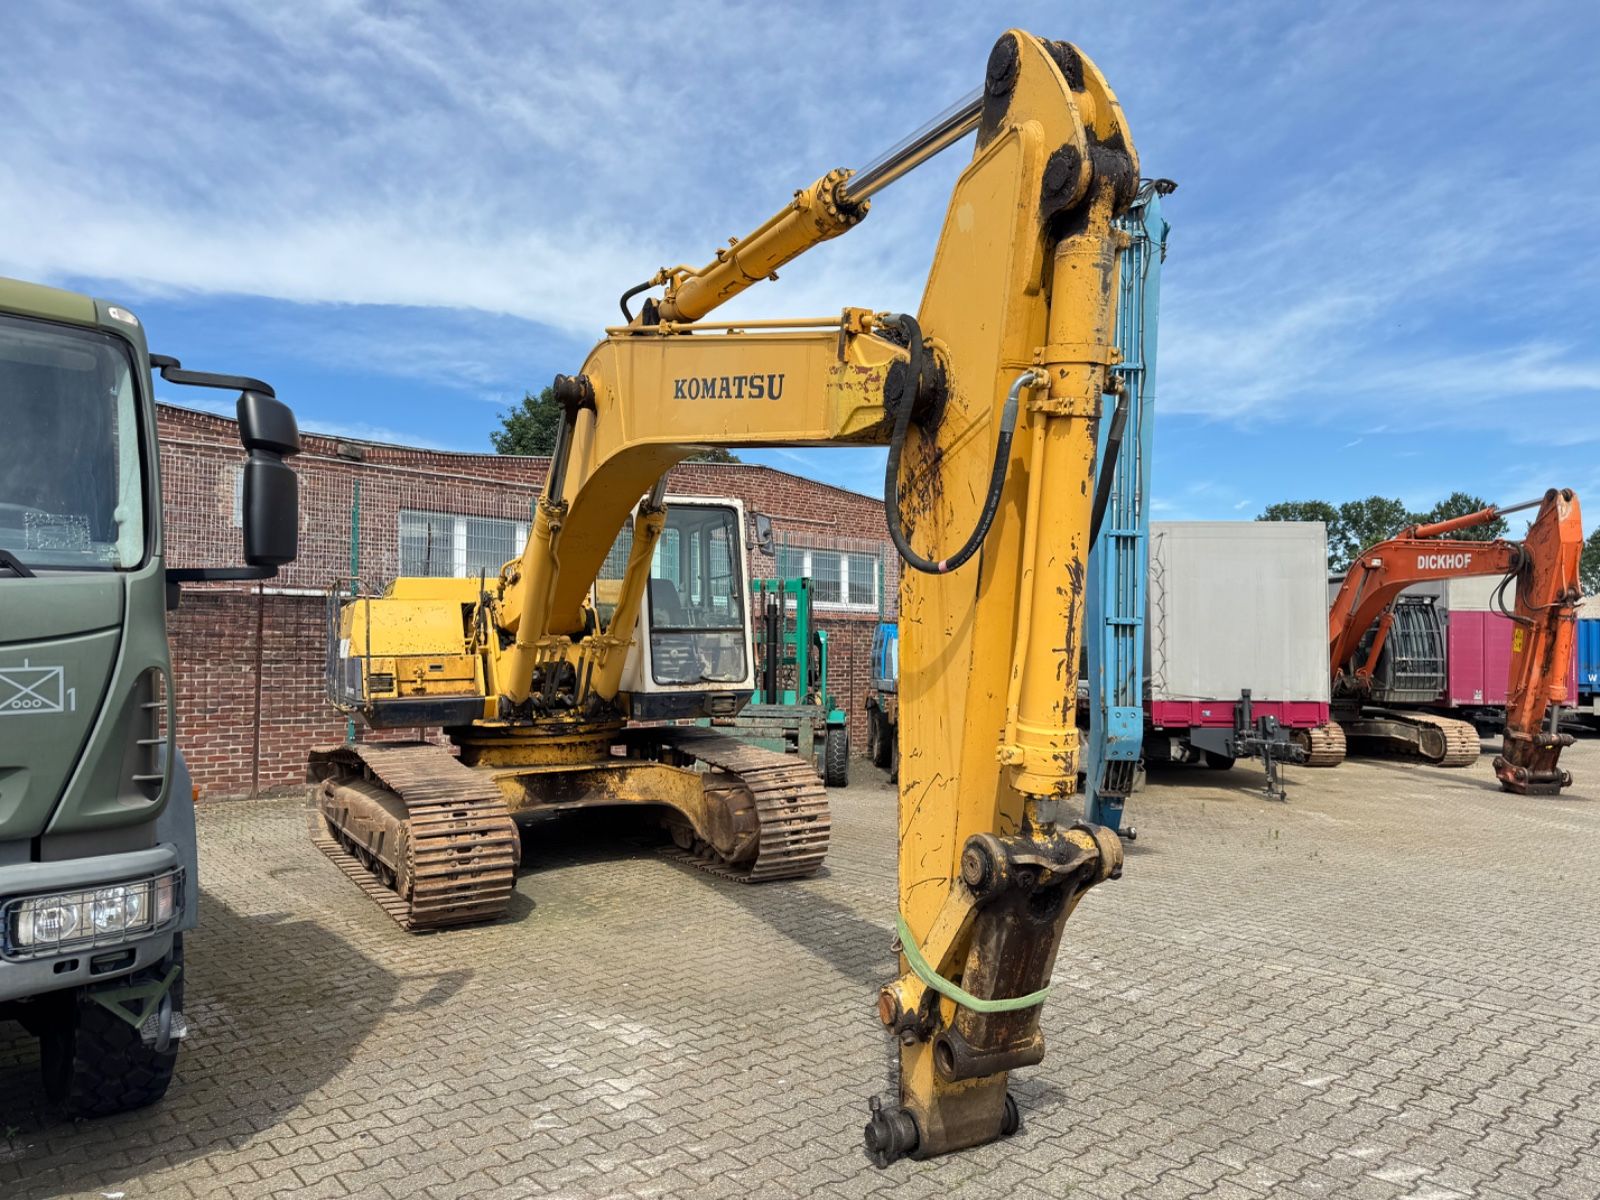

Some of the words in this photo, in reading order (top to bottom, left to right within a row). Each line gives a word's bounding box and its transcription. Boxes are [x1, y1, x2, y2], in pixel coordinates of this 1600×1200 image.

[673, 373, 785, 400] KOMATSU
[1417, 553, 1472, 570] DICKHOF
[1588, 674, 1598, 682] W
[66, 687, 76, 712] 1
